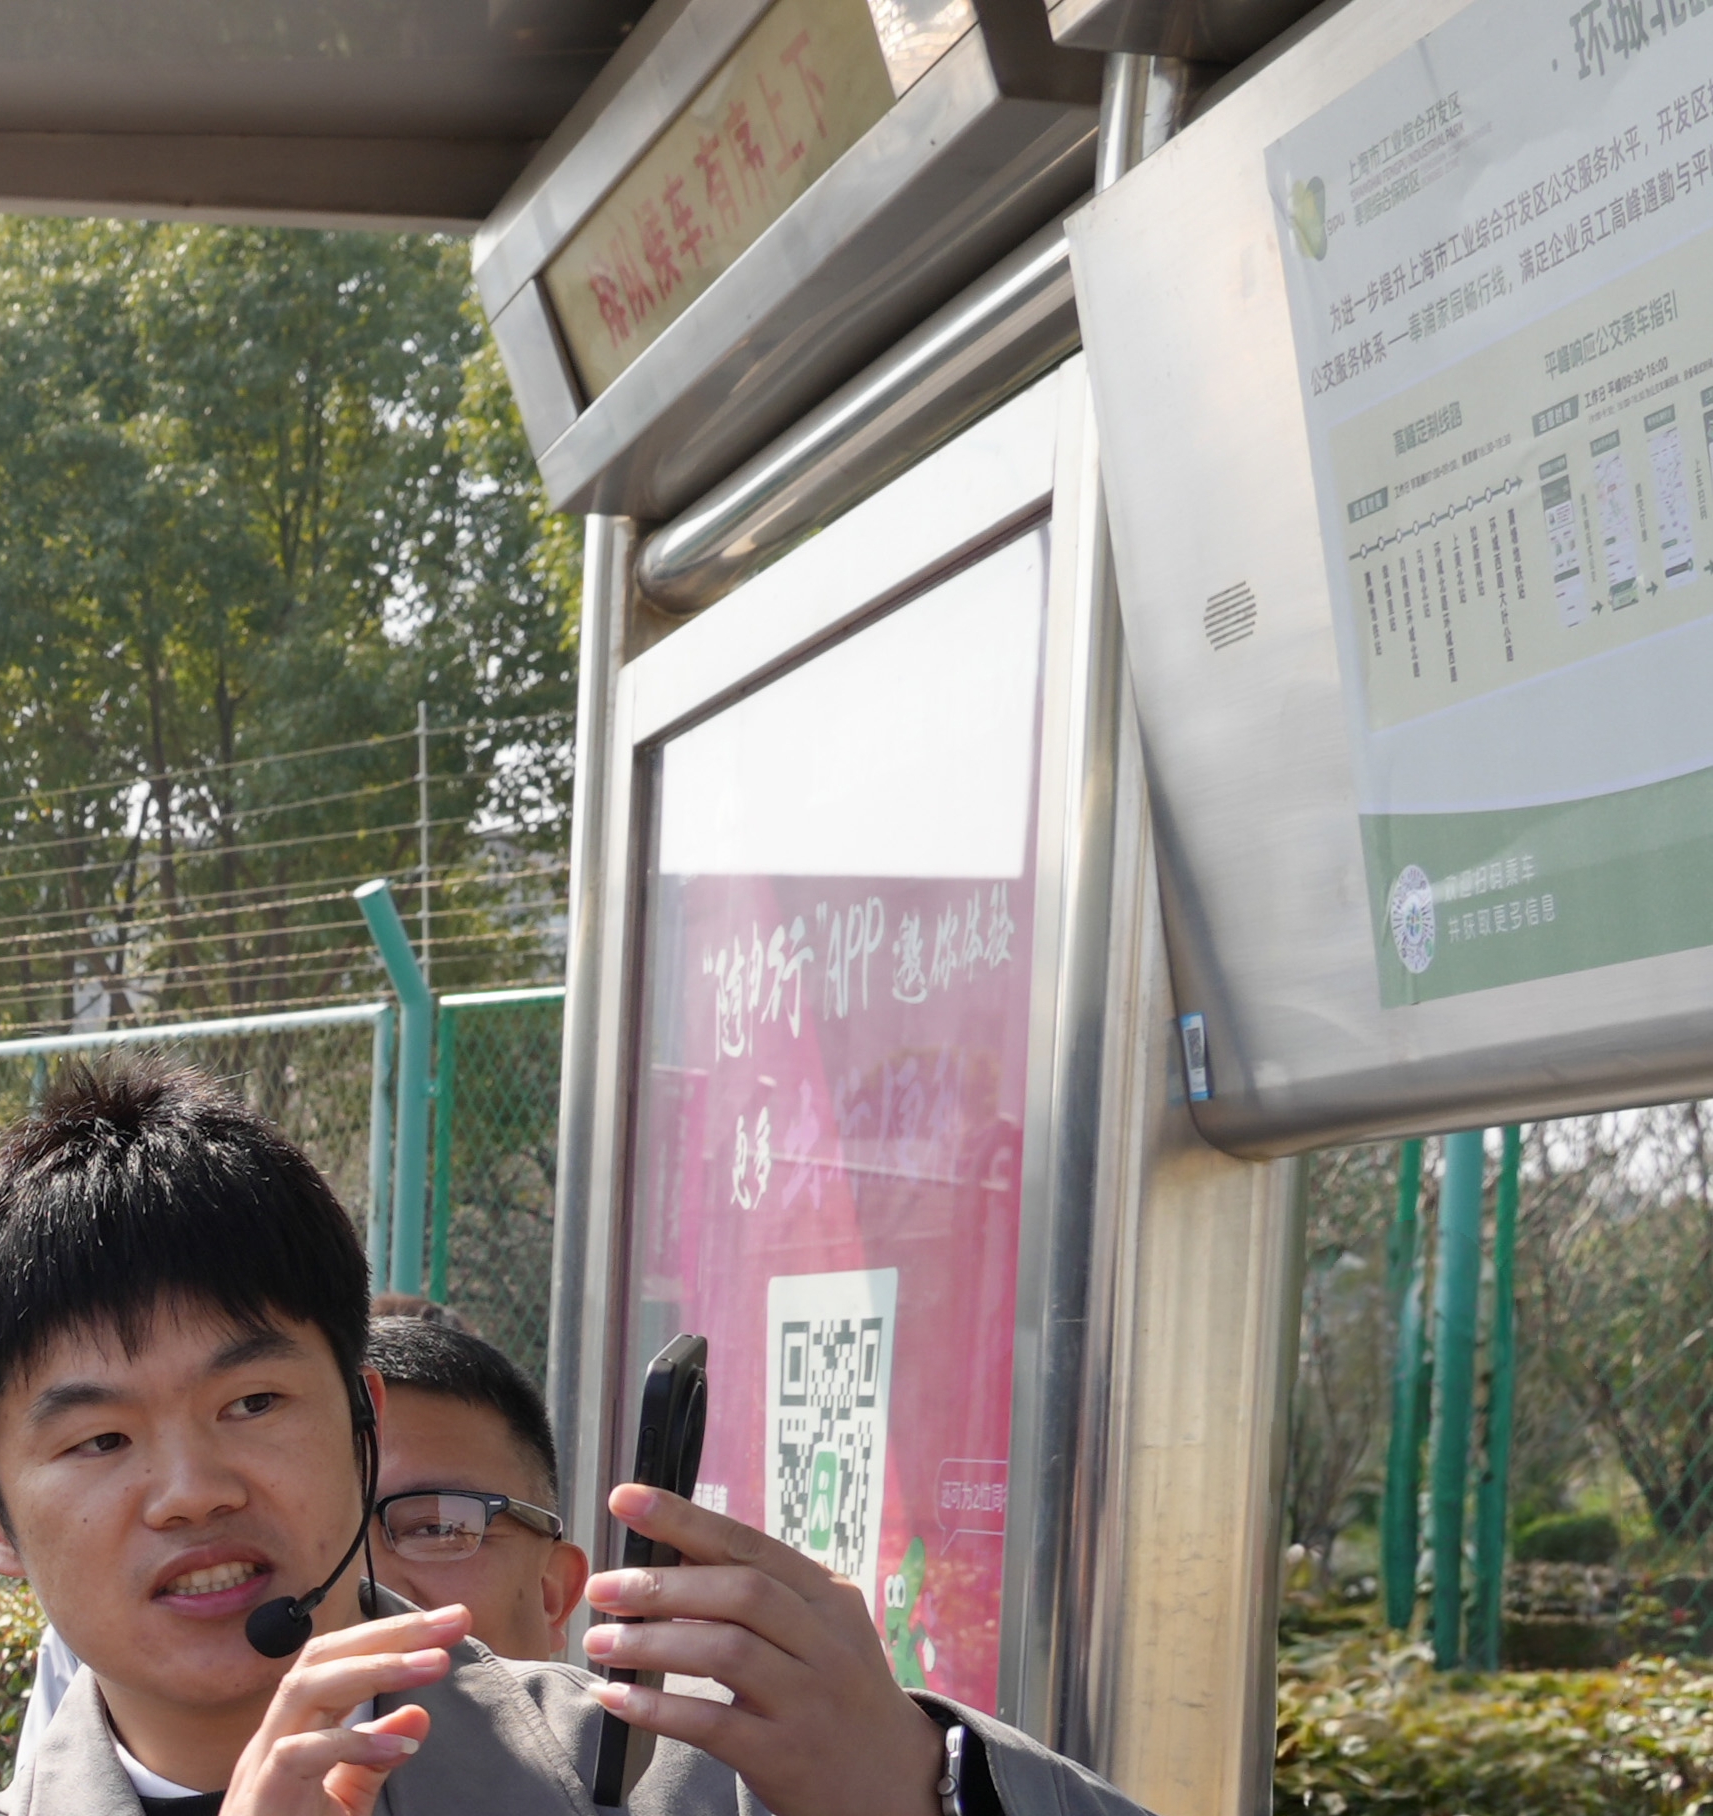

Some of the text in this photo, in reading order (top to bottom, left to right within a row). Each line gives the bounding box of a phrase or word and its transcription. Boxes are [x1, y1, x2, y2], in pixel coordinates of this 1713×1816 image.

[1348, 90, 1463, 186] 上海市工业综合开发区
[1544, 289, 1678, 380] 平峰响应公交乘车指引
[1393, 401, 1463, 457] 高峰定制线路
[1448, 894, 1556, 943] 并获取更多信息
